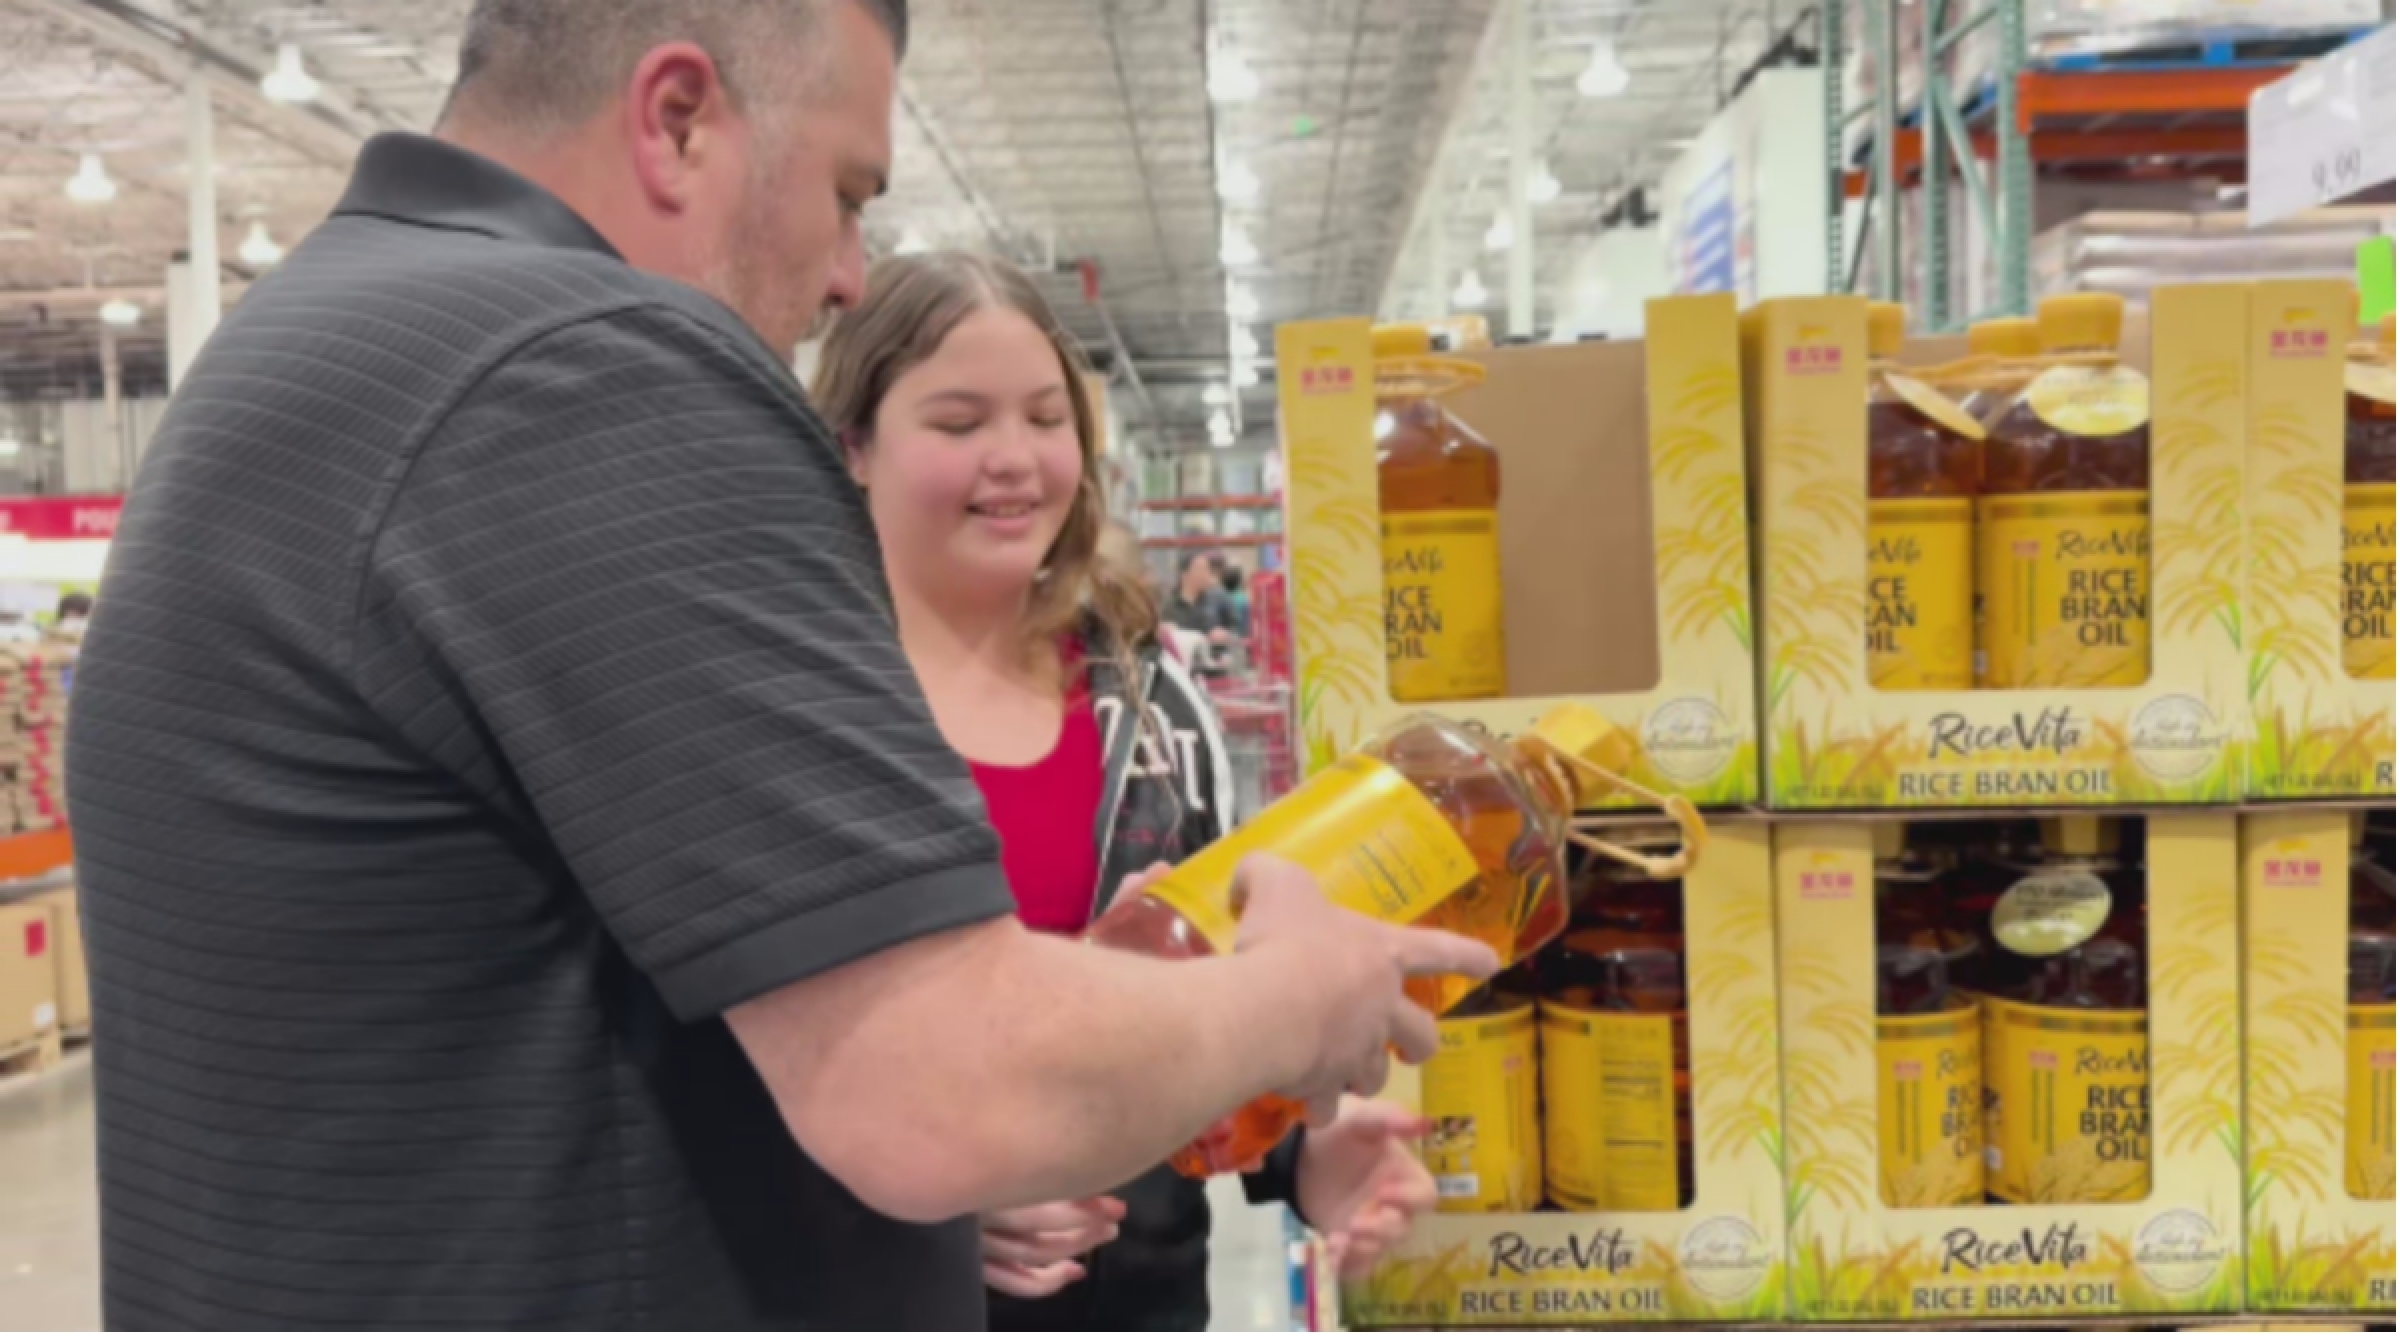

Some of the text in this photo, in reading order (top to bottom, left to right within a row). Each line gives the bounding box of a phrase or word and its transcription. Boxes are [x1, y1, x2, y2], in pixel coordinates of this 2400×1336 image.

[2069, 569, 2138, 594] RICE
[2060, 593, 2147, 622] BRAN
[2078, 621, 2128, 647] OIL
[2343, 613, 2392, 640] OIL
[1929, 706, 2083, 759] RiceVita
[1900, 771, 1962, 796] RICE
[1975, 769, 2057, 795] BRAN
[2064, 766, 2112, 795] OIL
[2096, 1136, 2148, 1162] OIL
[1488, 1227, 1636, 1278] RiceVita
[1940, 1219, 2090, 1275] RiceVita
[1461, 1290, 1523, 1314] RICE
[1533, 1288, 1612, 1314] BRAN
[1620, 1287, 1663, 1313] OIL
[1911, 1286, 1974, 1310] RICE
[1986, 1283, 2066, 1309] BRAN
[2071, 1283, 2118, 1307] OIL
